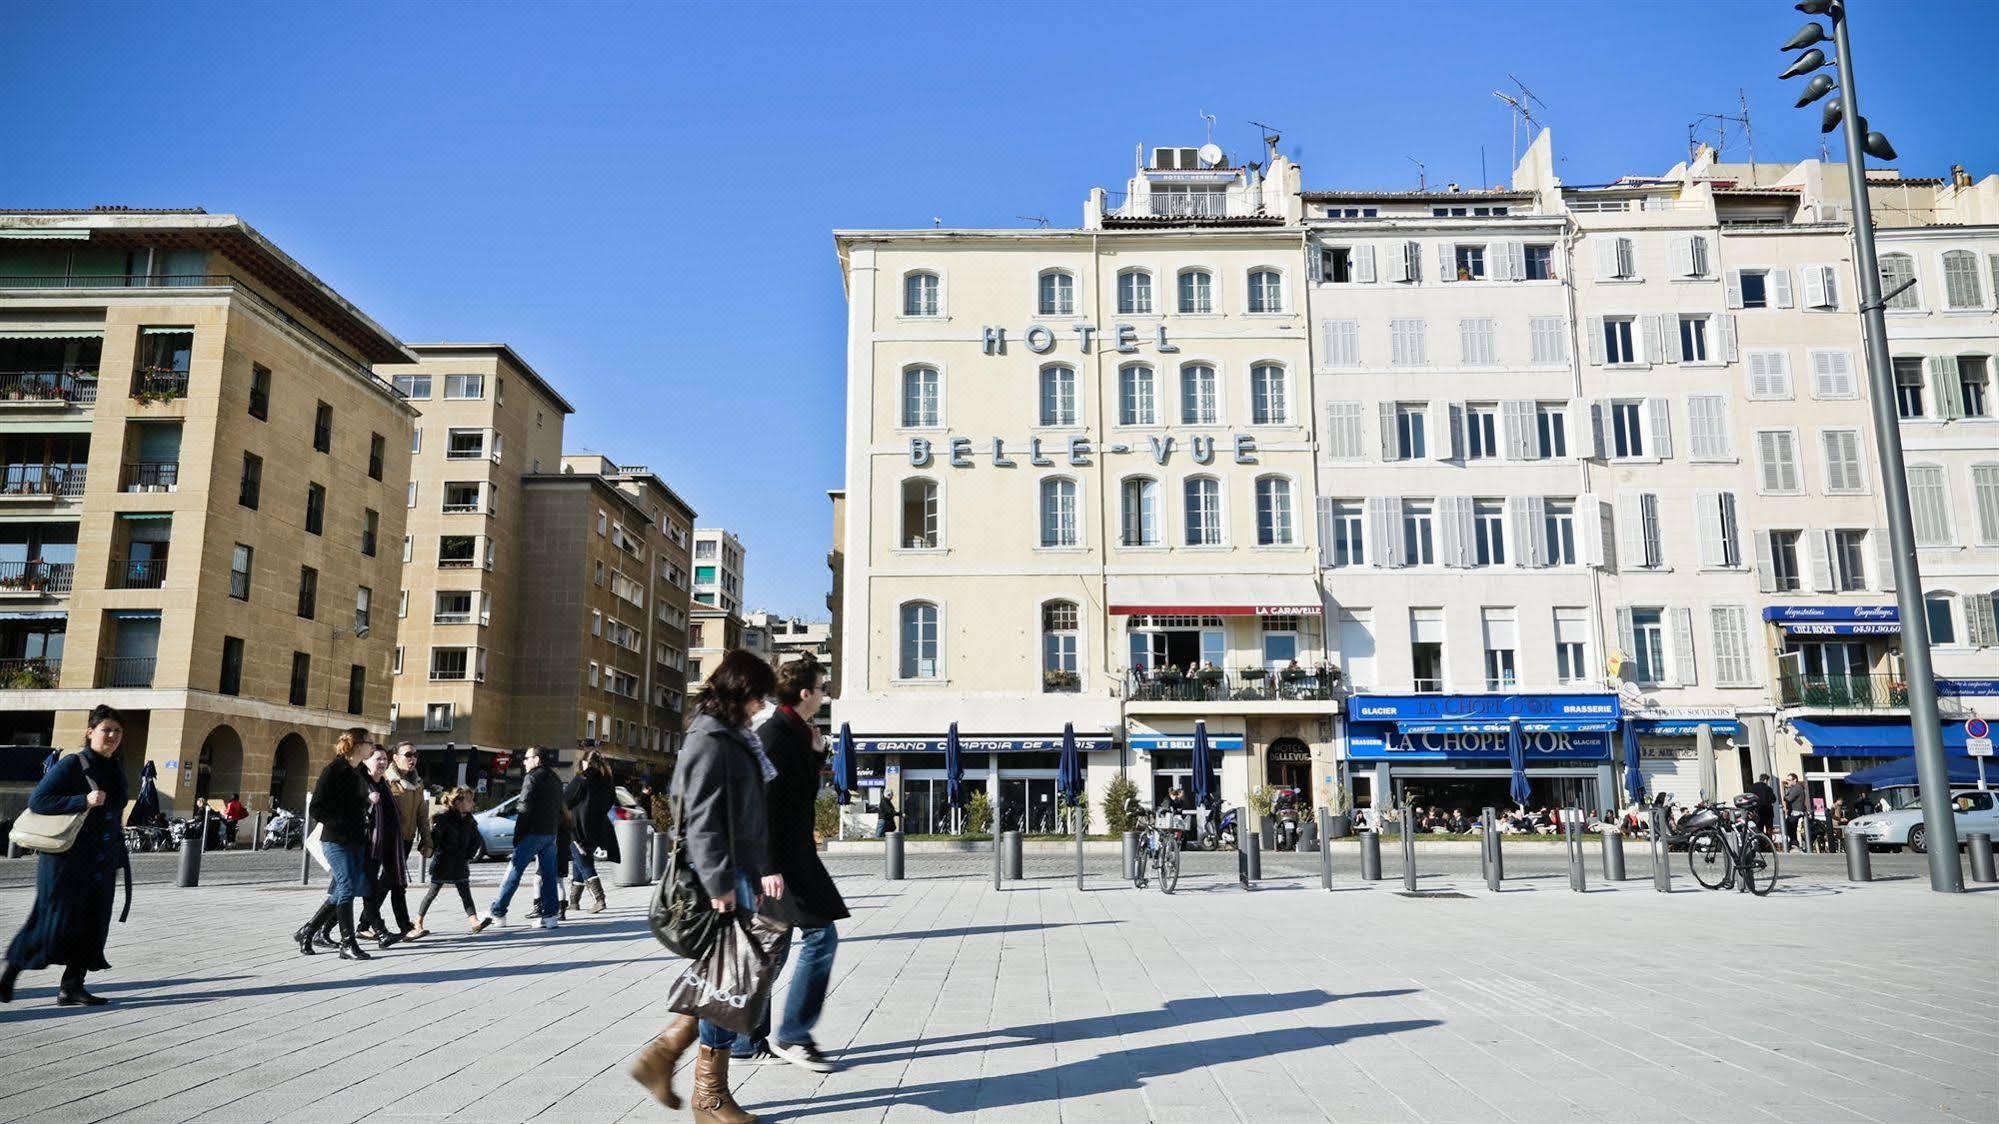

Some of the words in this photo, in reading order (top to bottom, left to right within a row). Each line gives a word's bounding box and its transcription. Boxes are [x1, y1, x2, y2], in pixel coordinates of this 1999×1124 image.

[982, 323, 1178, 356] HOTEL
[908, 433, 1258, 468] BELLE-VUE
[1255, 606, 1268, 615] LA
[1270, 606, 1322, 616] CARAVELLE
[1361, 707, 1398, 715] GLACIER
[1563, 705, 1613, 713] BRASSERIE
[877, 742, 927, 750] GRAND
[937, 741, 1013, 751] CMPTOIR
[1022, 741, 1043, 749] DE
[1156, 741, 1169, 749] LE
[1384, 731, 1416, 752] LA
[1421, 731, 1506, 752] CHOPE
